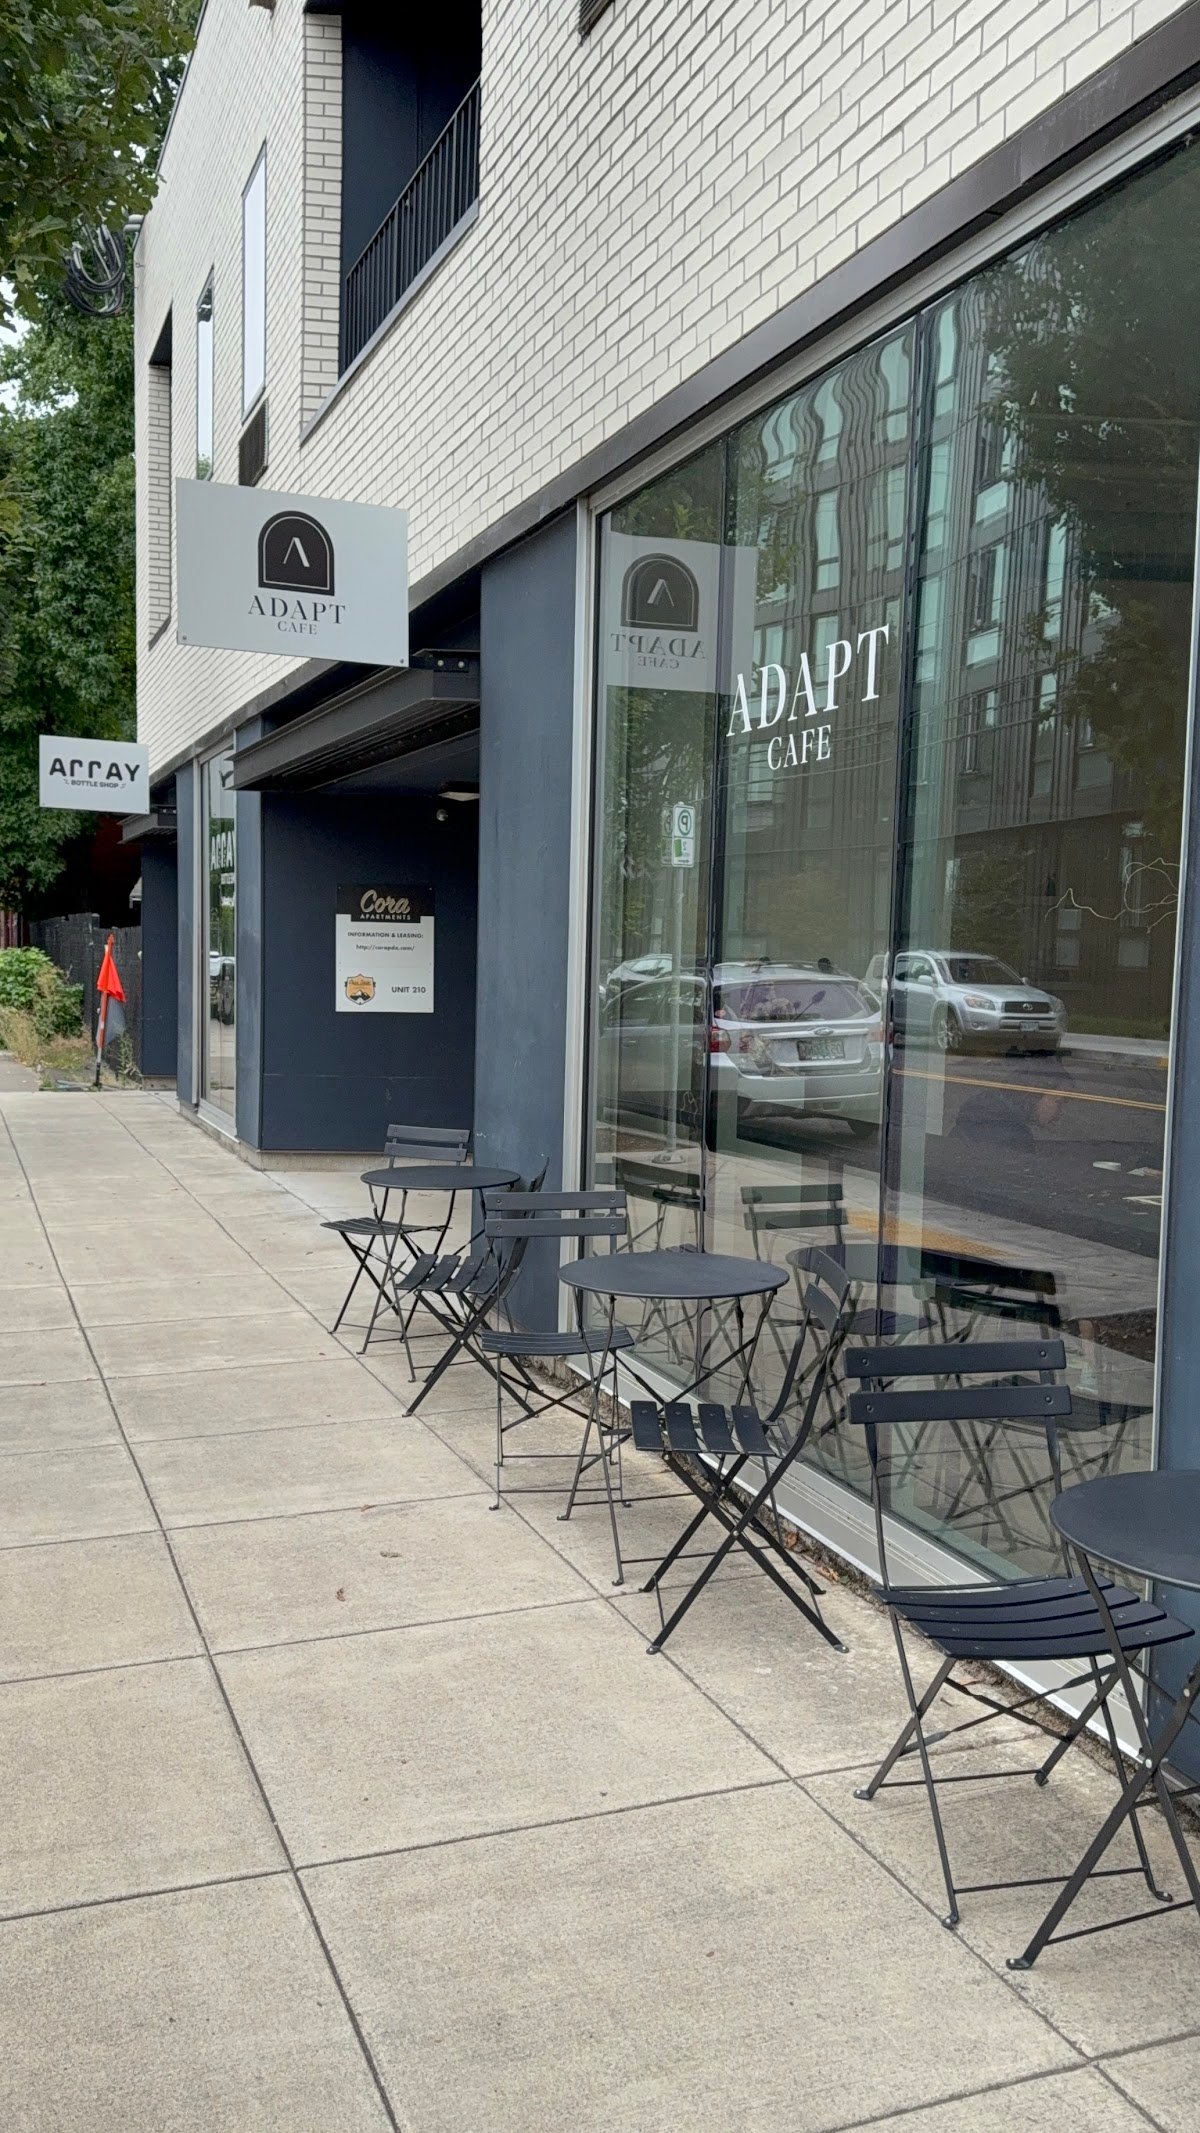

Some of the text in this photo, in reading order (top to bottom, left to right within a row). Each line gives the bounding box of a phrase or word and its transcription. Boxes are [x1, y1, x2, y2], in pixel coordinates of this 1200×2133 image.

[248, 595, 346, 624] ADAPT
[277, 620, 318, 635] CAFE
[726, 623, 889, 737] ADAPT
[767, 724, 831, 770] CAFE
[71, 779, 98, 788] BOTTLE
[360, 889, 411, 914] Cora
[391, 986, 426, 994] UNIT 210
